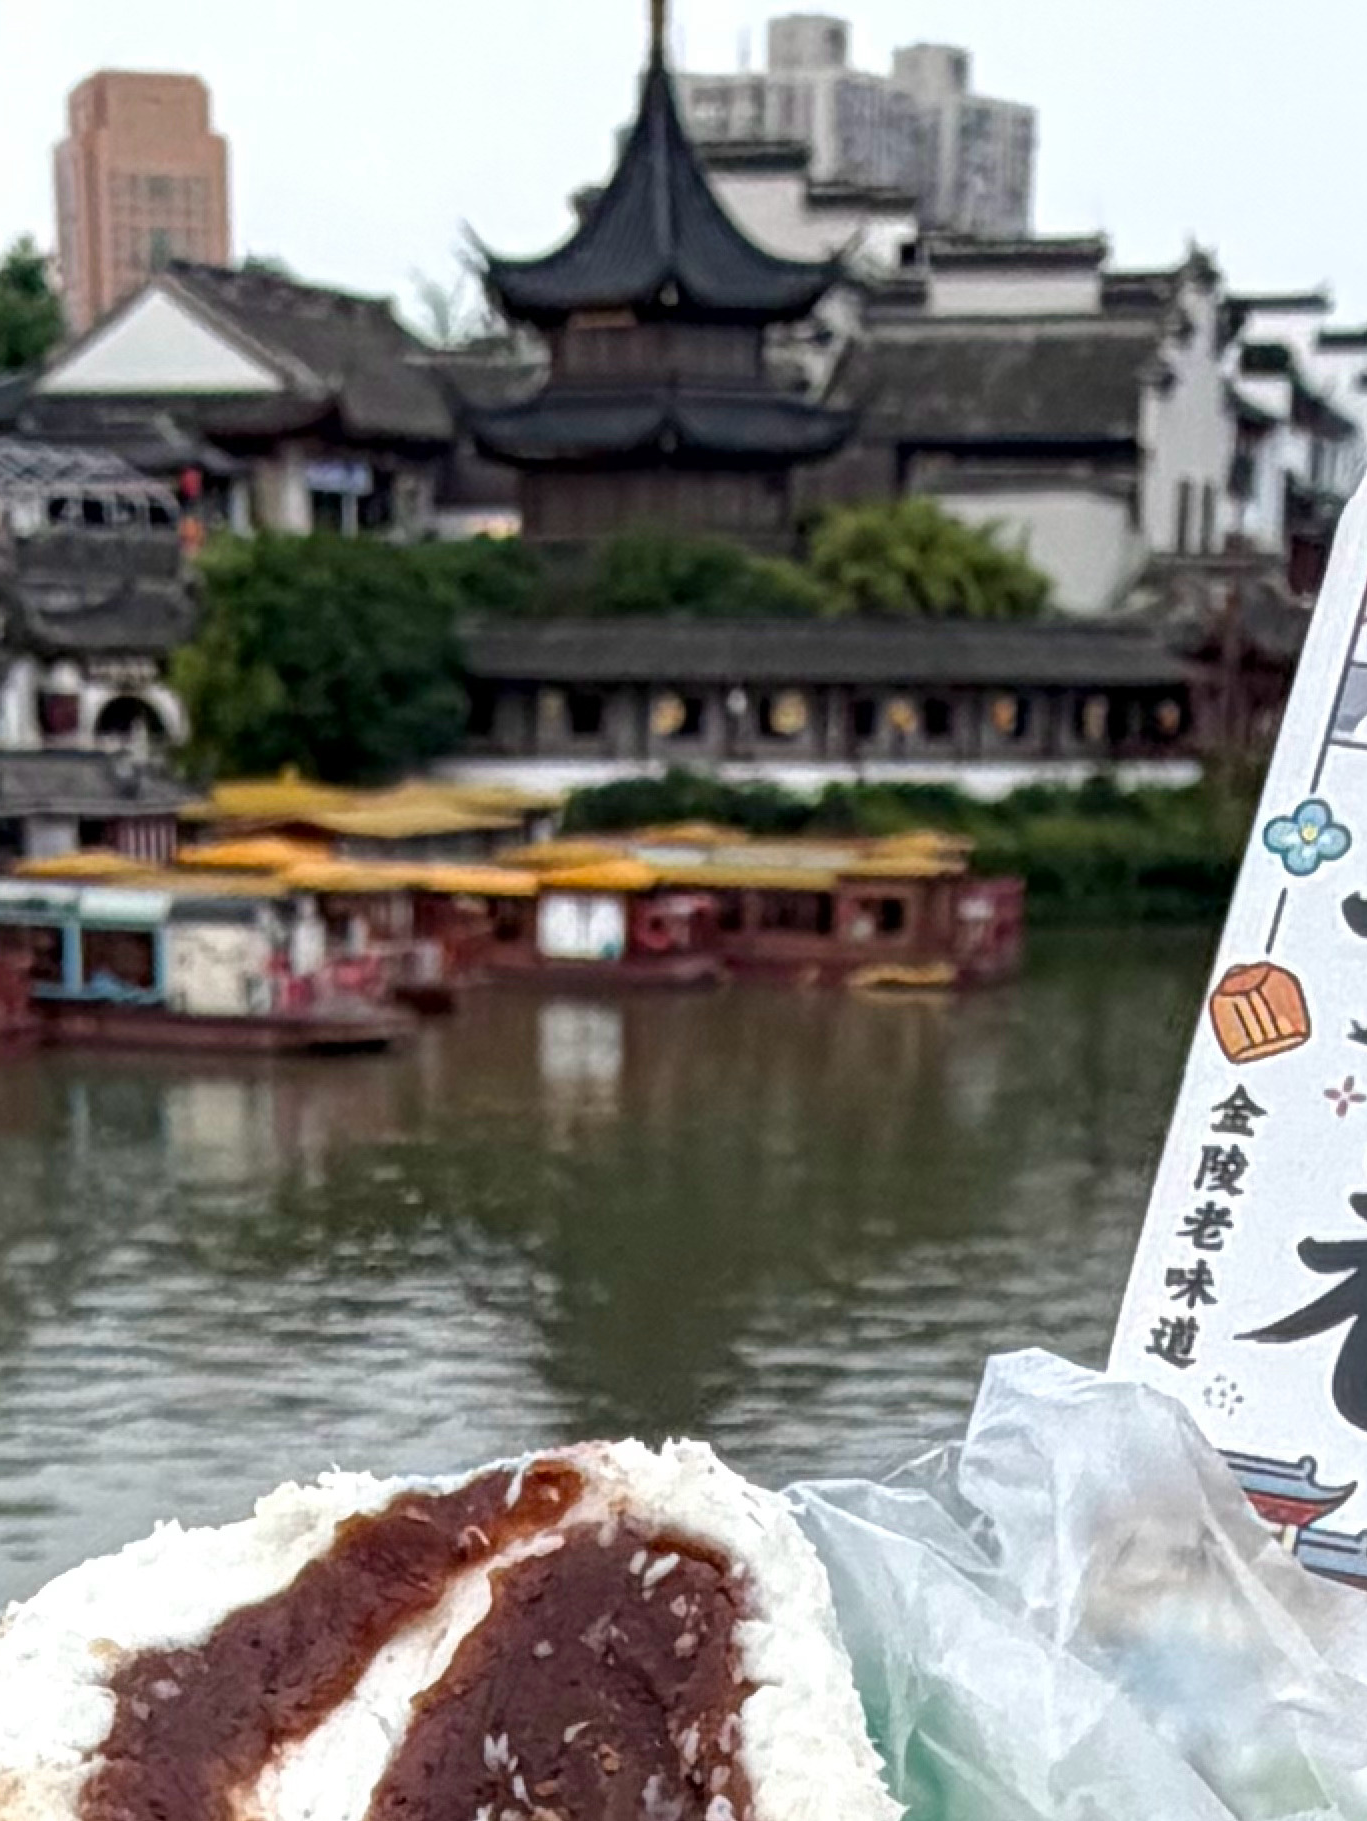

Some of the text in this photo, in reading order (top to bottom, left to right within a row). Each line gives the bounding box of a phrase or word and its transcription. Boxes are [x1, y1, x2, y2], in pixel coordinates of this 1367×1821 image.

[1144, 1083, 1268, 1370] 金陵老味道
